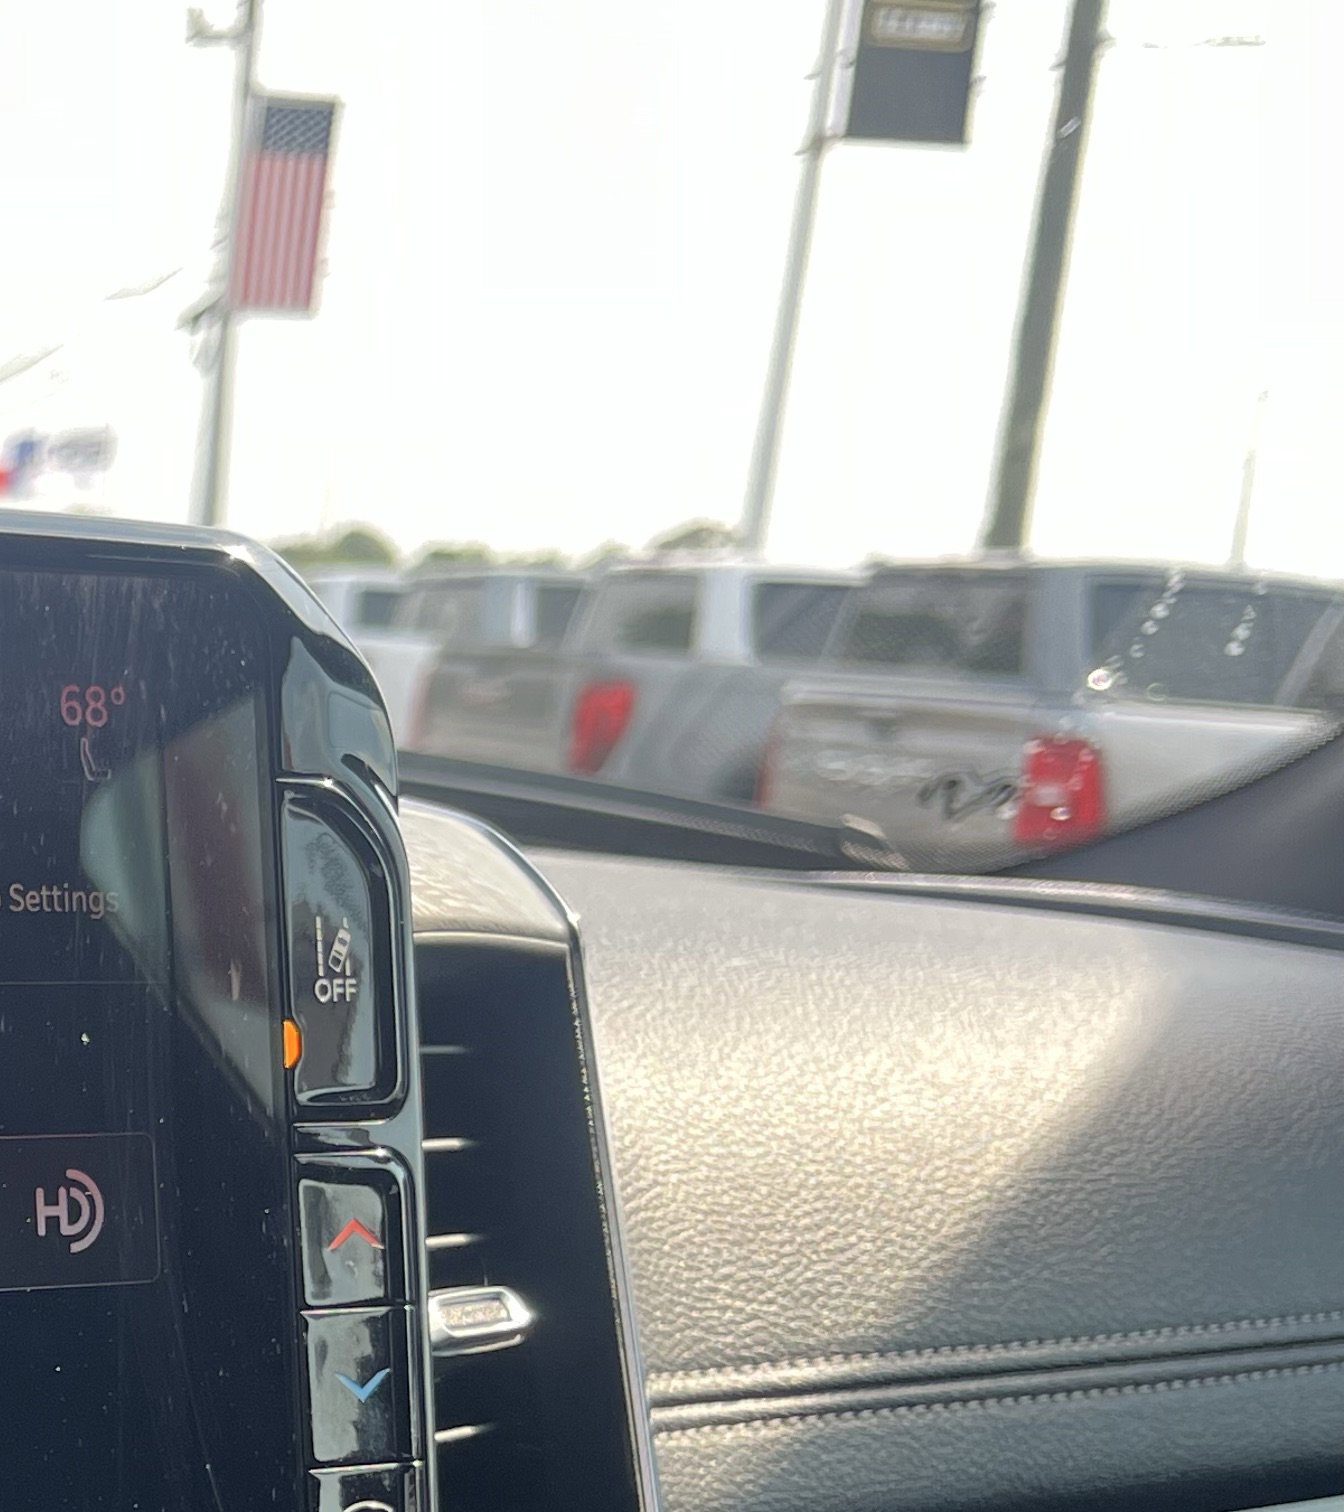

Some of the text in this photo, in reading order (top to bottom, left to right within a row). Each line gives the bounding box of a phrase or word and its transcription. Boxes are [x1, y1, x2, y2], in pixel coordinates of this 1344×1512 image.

[58, 682, 127, 728] 68°
[8, 882, 120, 921] Settings
[314, 978, 357, 1003] OFF
